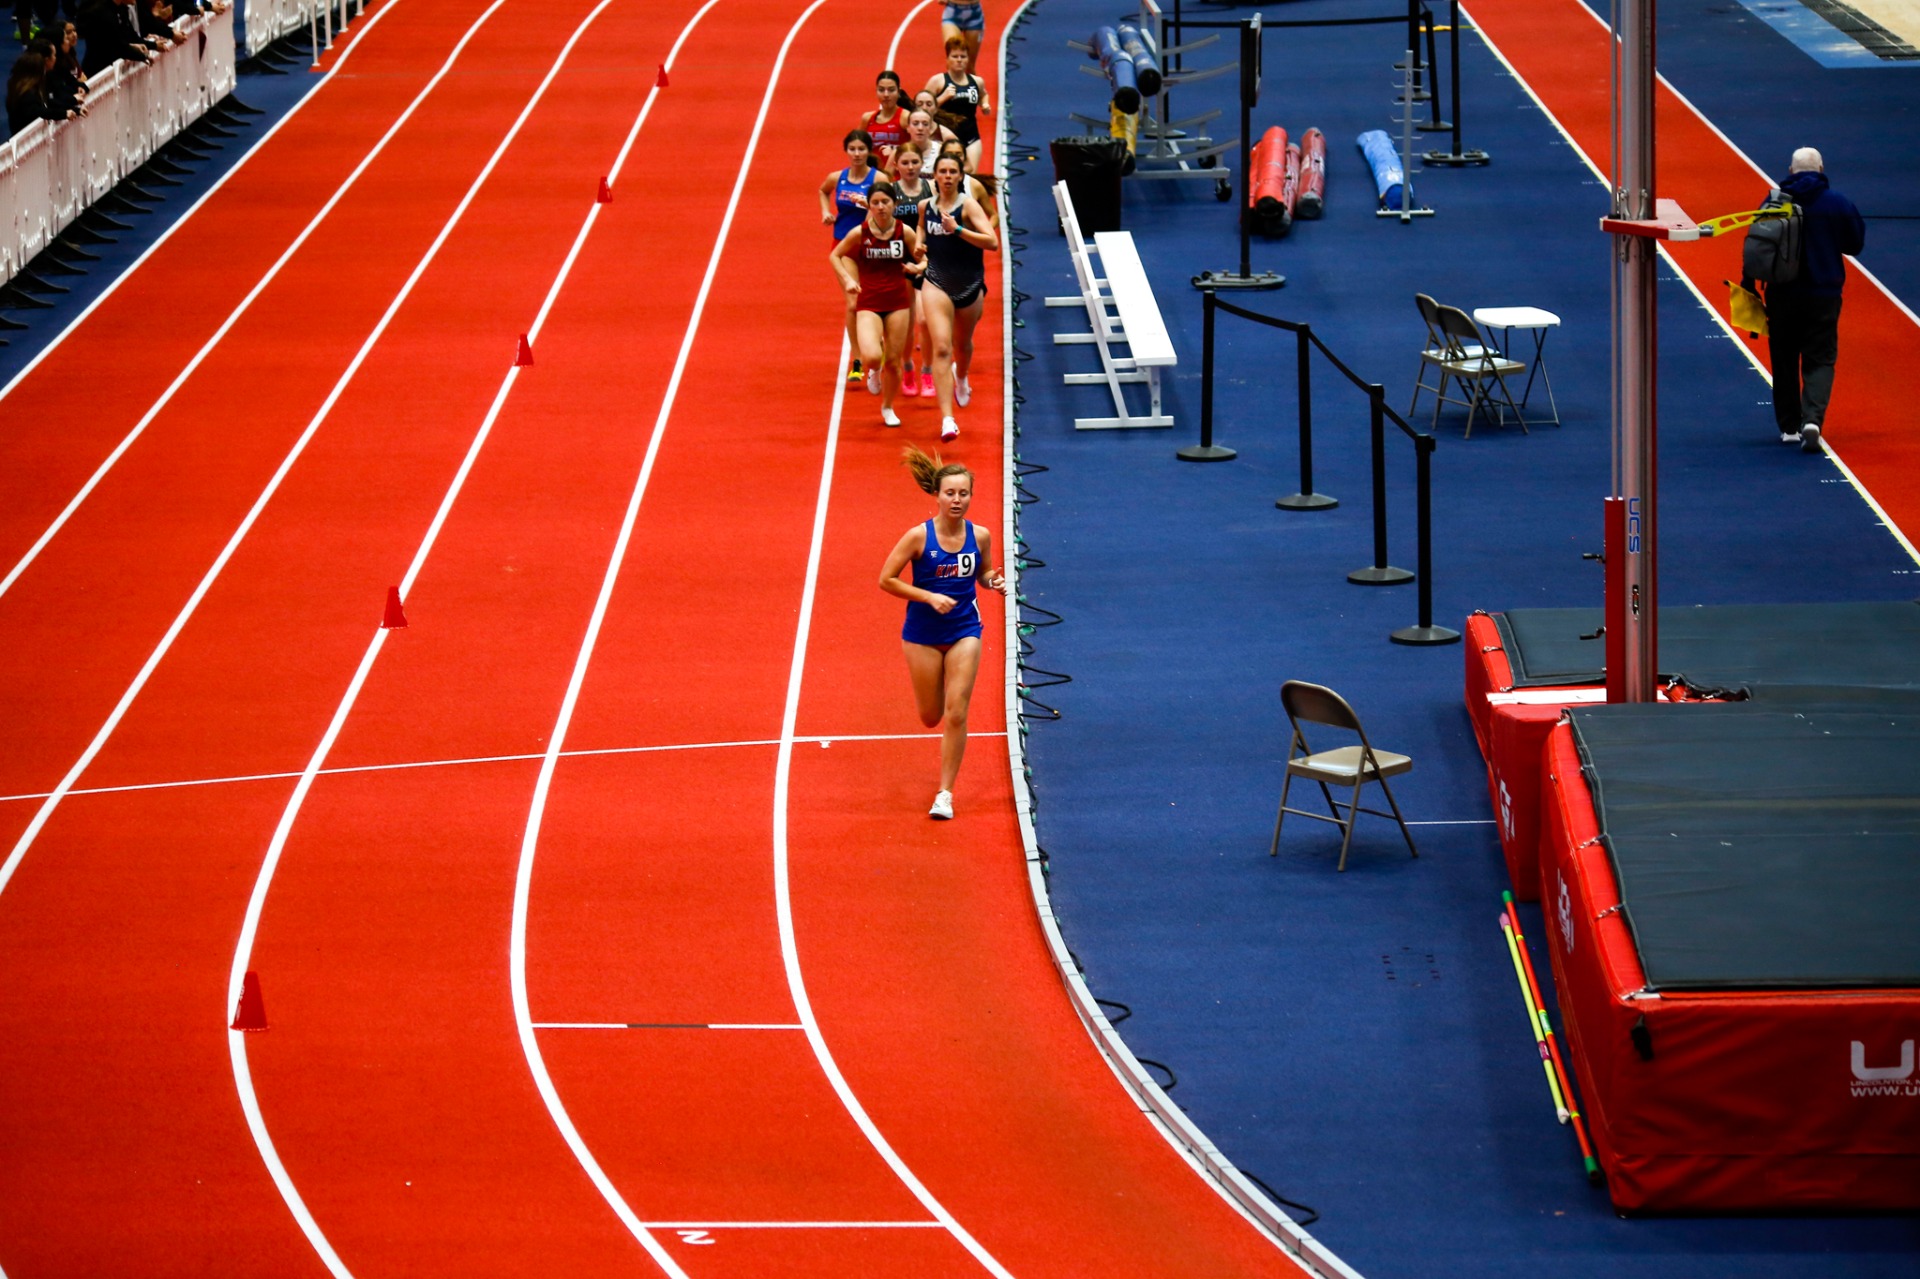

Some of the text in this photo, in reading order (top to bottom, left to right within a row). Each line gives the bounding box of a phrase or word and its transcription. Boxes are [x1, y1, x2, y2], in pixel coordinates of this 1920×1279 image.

[970, 90, 977, 102] 8
[893, 241, 902, 257] 3
[1629, 497, 1640, 554] UCS
[961, 555, 972, 576] 9
[1851, 1039, 1920, 1080] U
